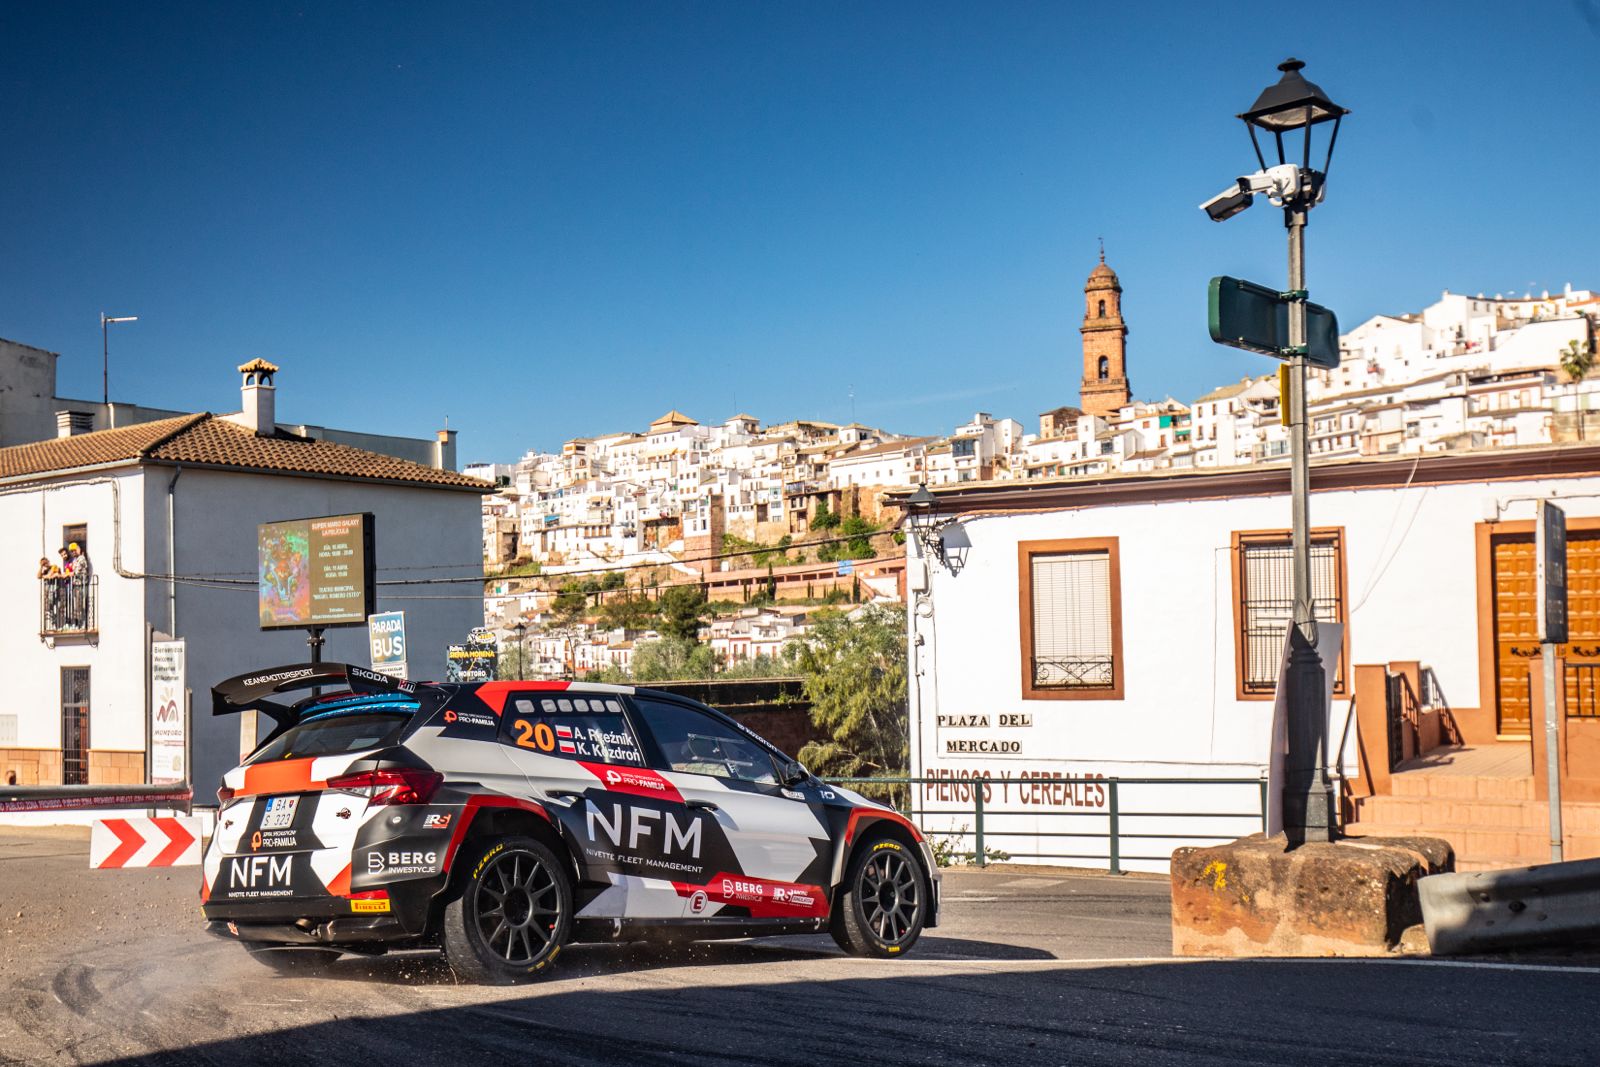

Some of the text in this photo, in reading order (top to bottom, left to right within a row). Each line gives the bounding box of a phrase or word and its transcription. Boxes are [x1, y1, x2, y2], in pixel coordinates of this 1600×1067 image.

[371, 620, 402, 634] PARADA
[373, 636, 403, 658] BUS
[449, 650, 495, 659] SIERRA MORENA
[458, 716, 495, 727] PRO-FAMILIA
[938, 714, 1029, 726] PLAZA DEL
[513, 719, 555, 752] 20
[574, 728, 586, 740] A.
[577, 742, 591, 756] K.
[946, 740, 1021, 753] MERCADO
[624, 778, 666, 791] PRO-FAMILIA
[1000, 770, 1011, 804] Y
[1019, 770, 1105, 807] CEREALES
[276, 799, 286, 811] BA
[274, 813, 290, 826] 323
[585, 798, 702, 859] NFM
[262, 837, 297, 848] PRO-FAMILIA
[388, 852, 437, 865] BERG
[586, 848, 703, 873] NIVETTE FLEET MANAGEMENT
[230, 855, 294, 888] NFM
[388, 866, 436, 874] INWESTYCJE
[735, 881, 763, 894] BERG
[354, 901, 386, 910] PIRELLI
[693, 895, 703, 909] E
